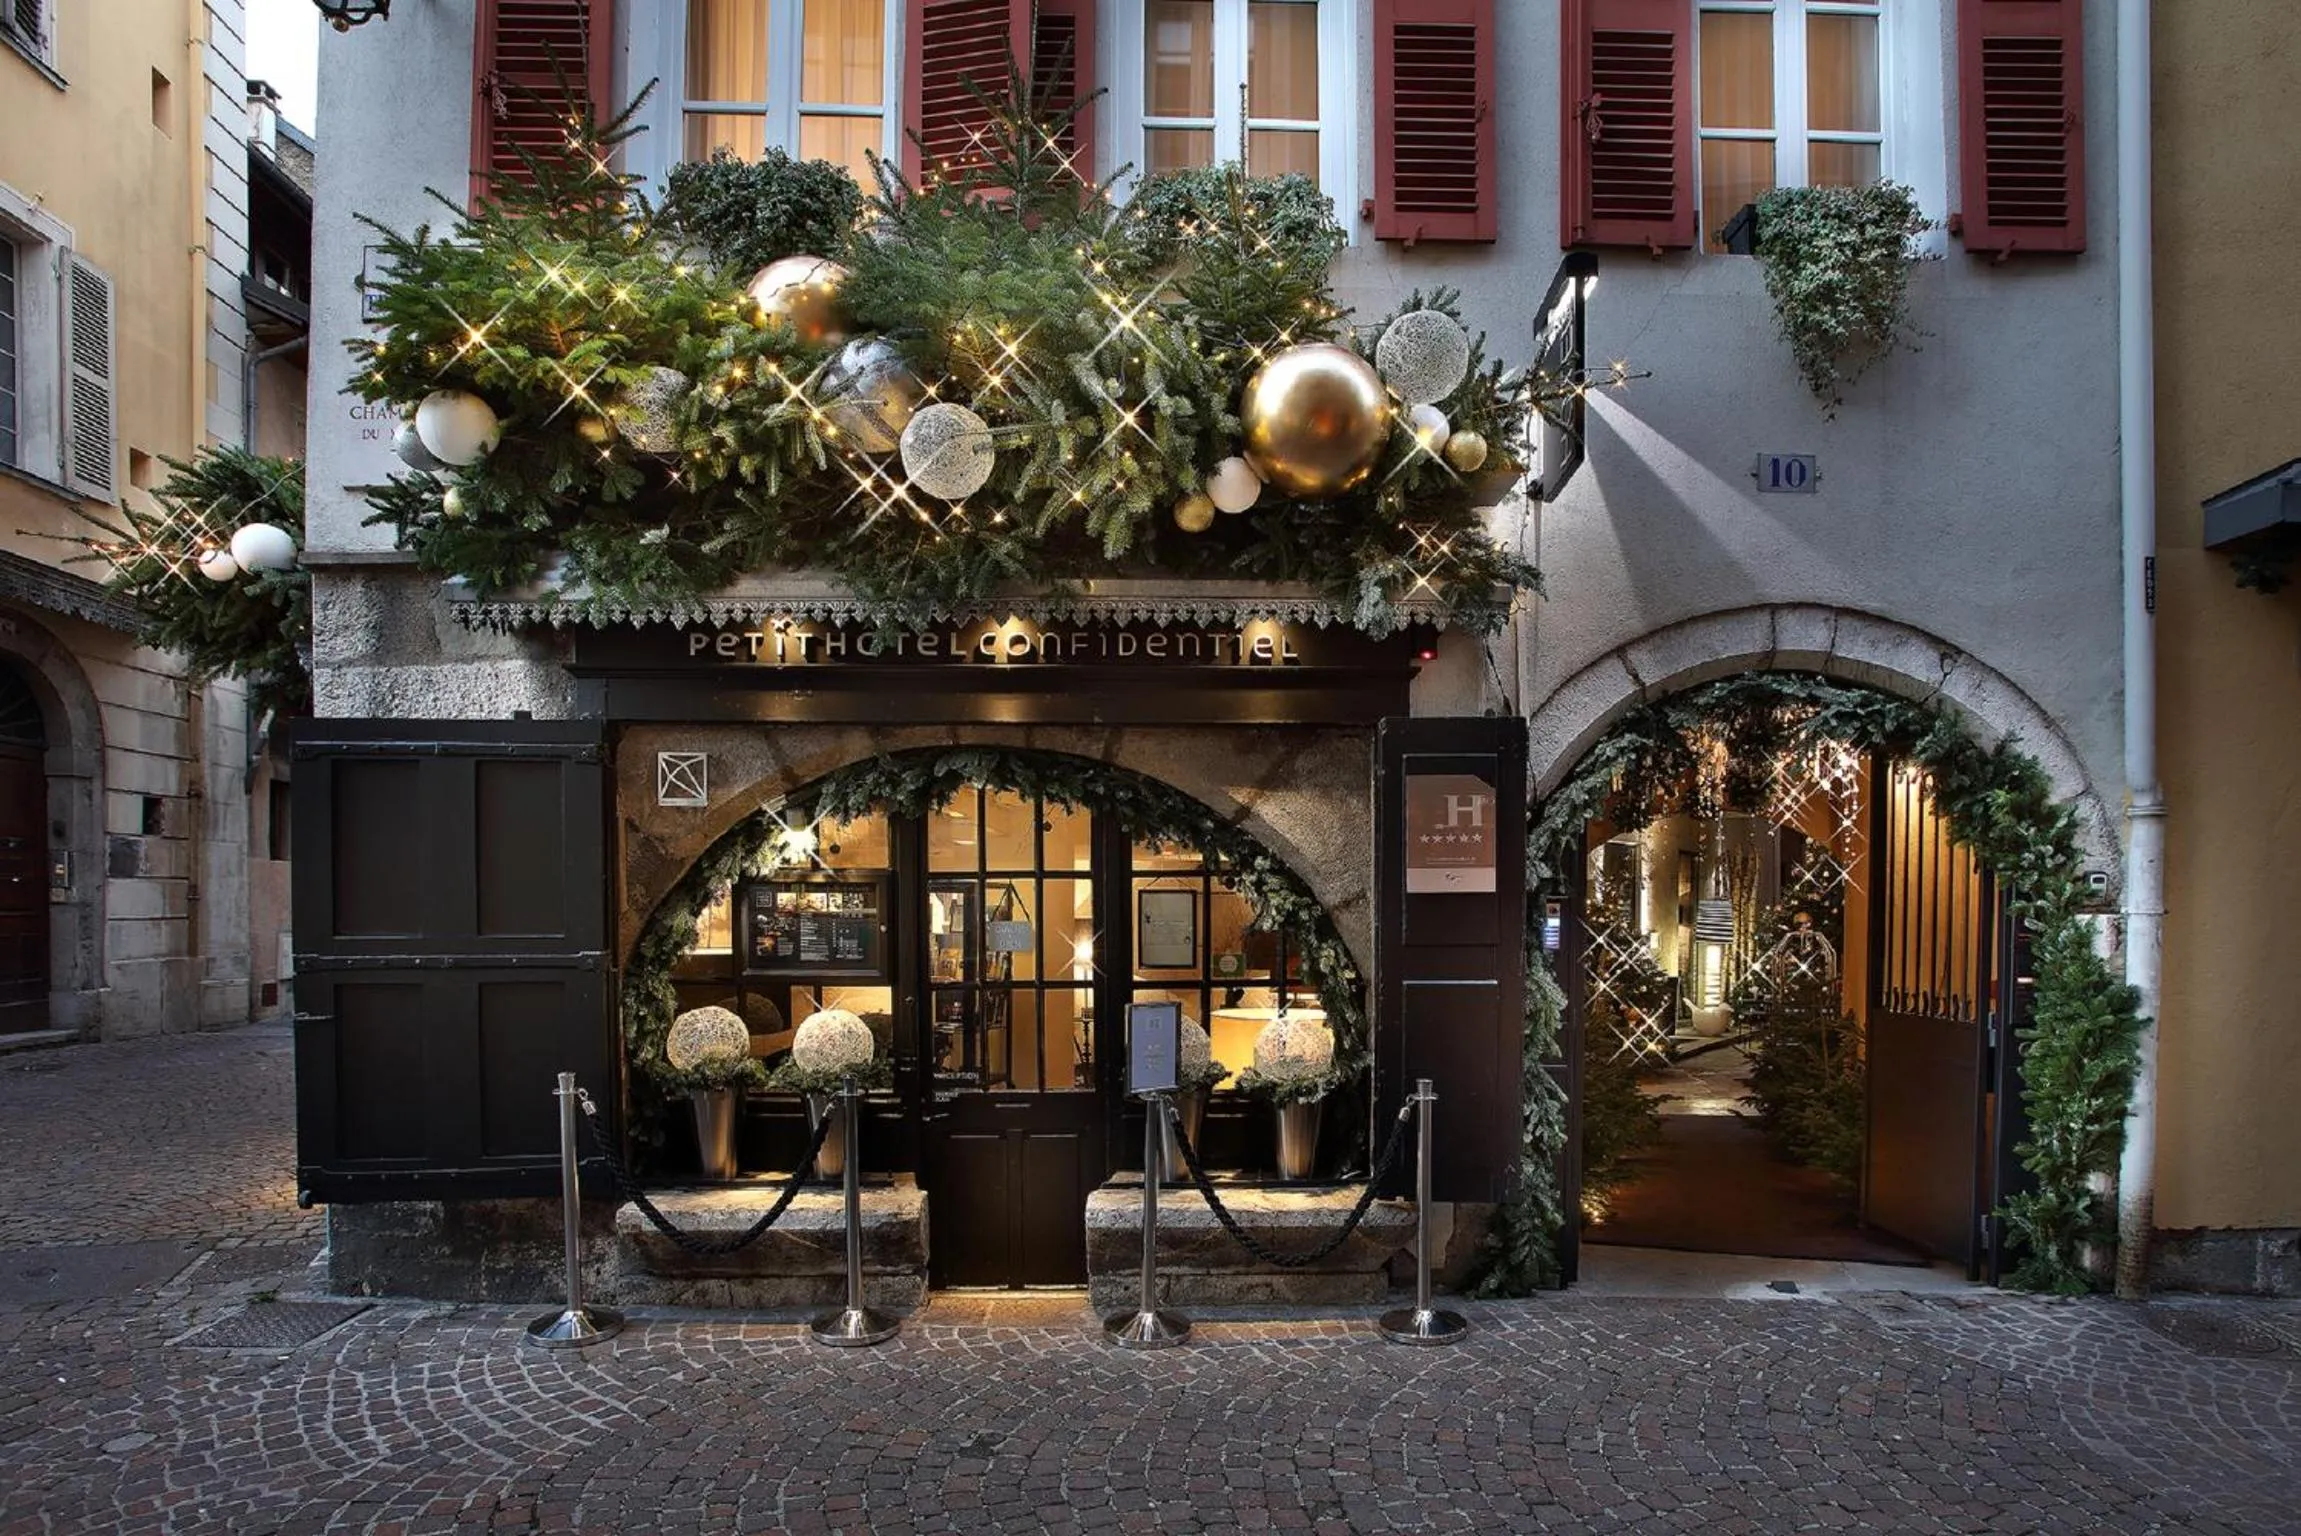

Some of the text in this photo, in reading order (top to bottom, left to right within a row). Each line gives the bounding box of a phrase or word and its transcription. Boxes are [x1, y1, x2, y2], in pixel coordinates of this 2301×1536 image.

[349, 406, 403, 420] CHAM
[1768, 456, 1807, 488] 10
[1444, 794, 1485, 827] H
